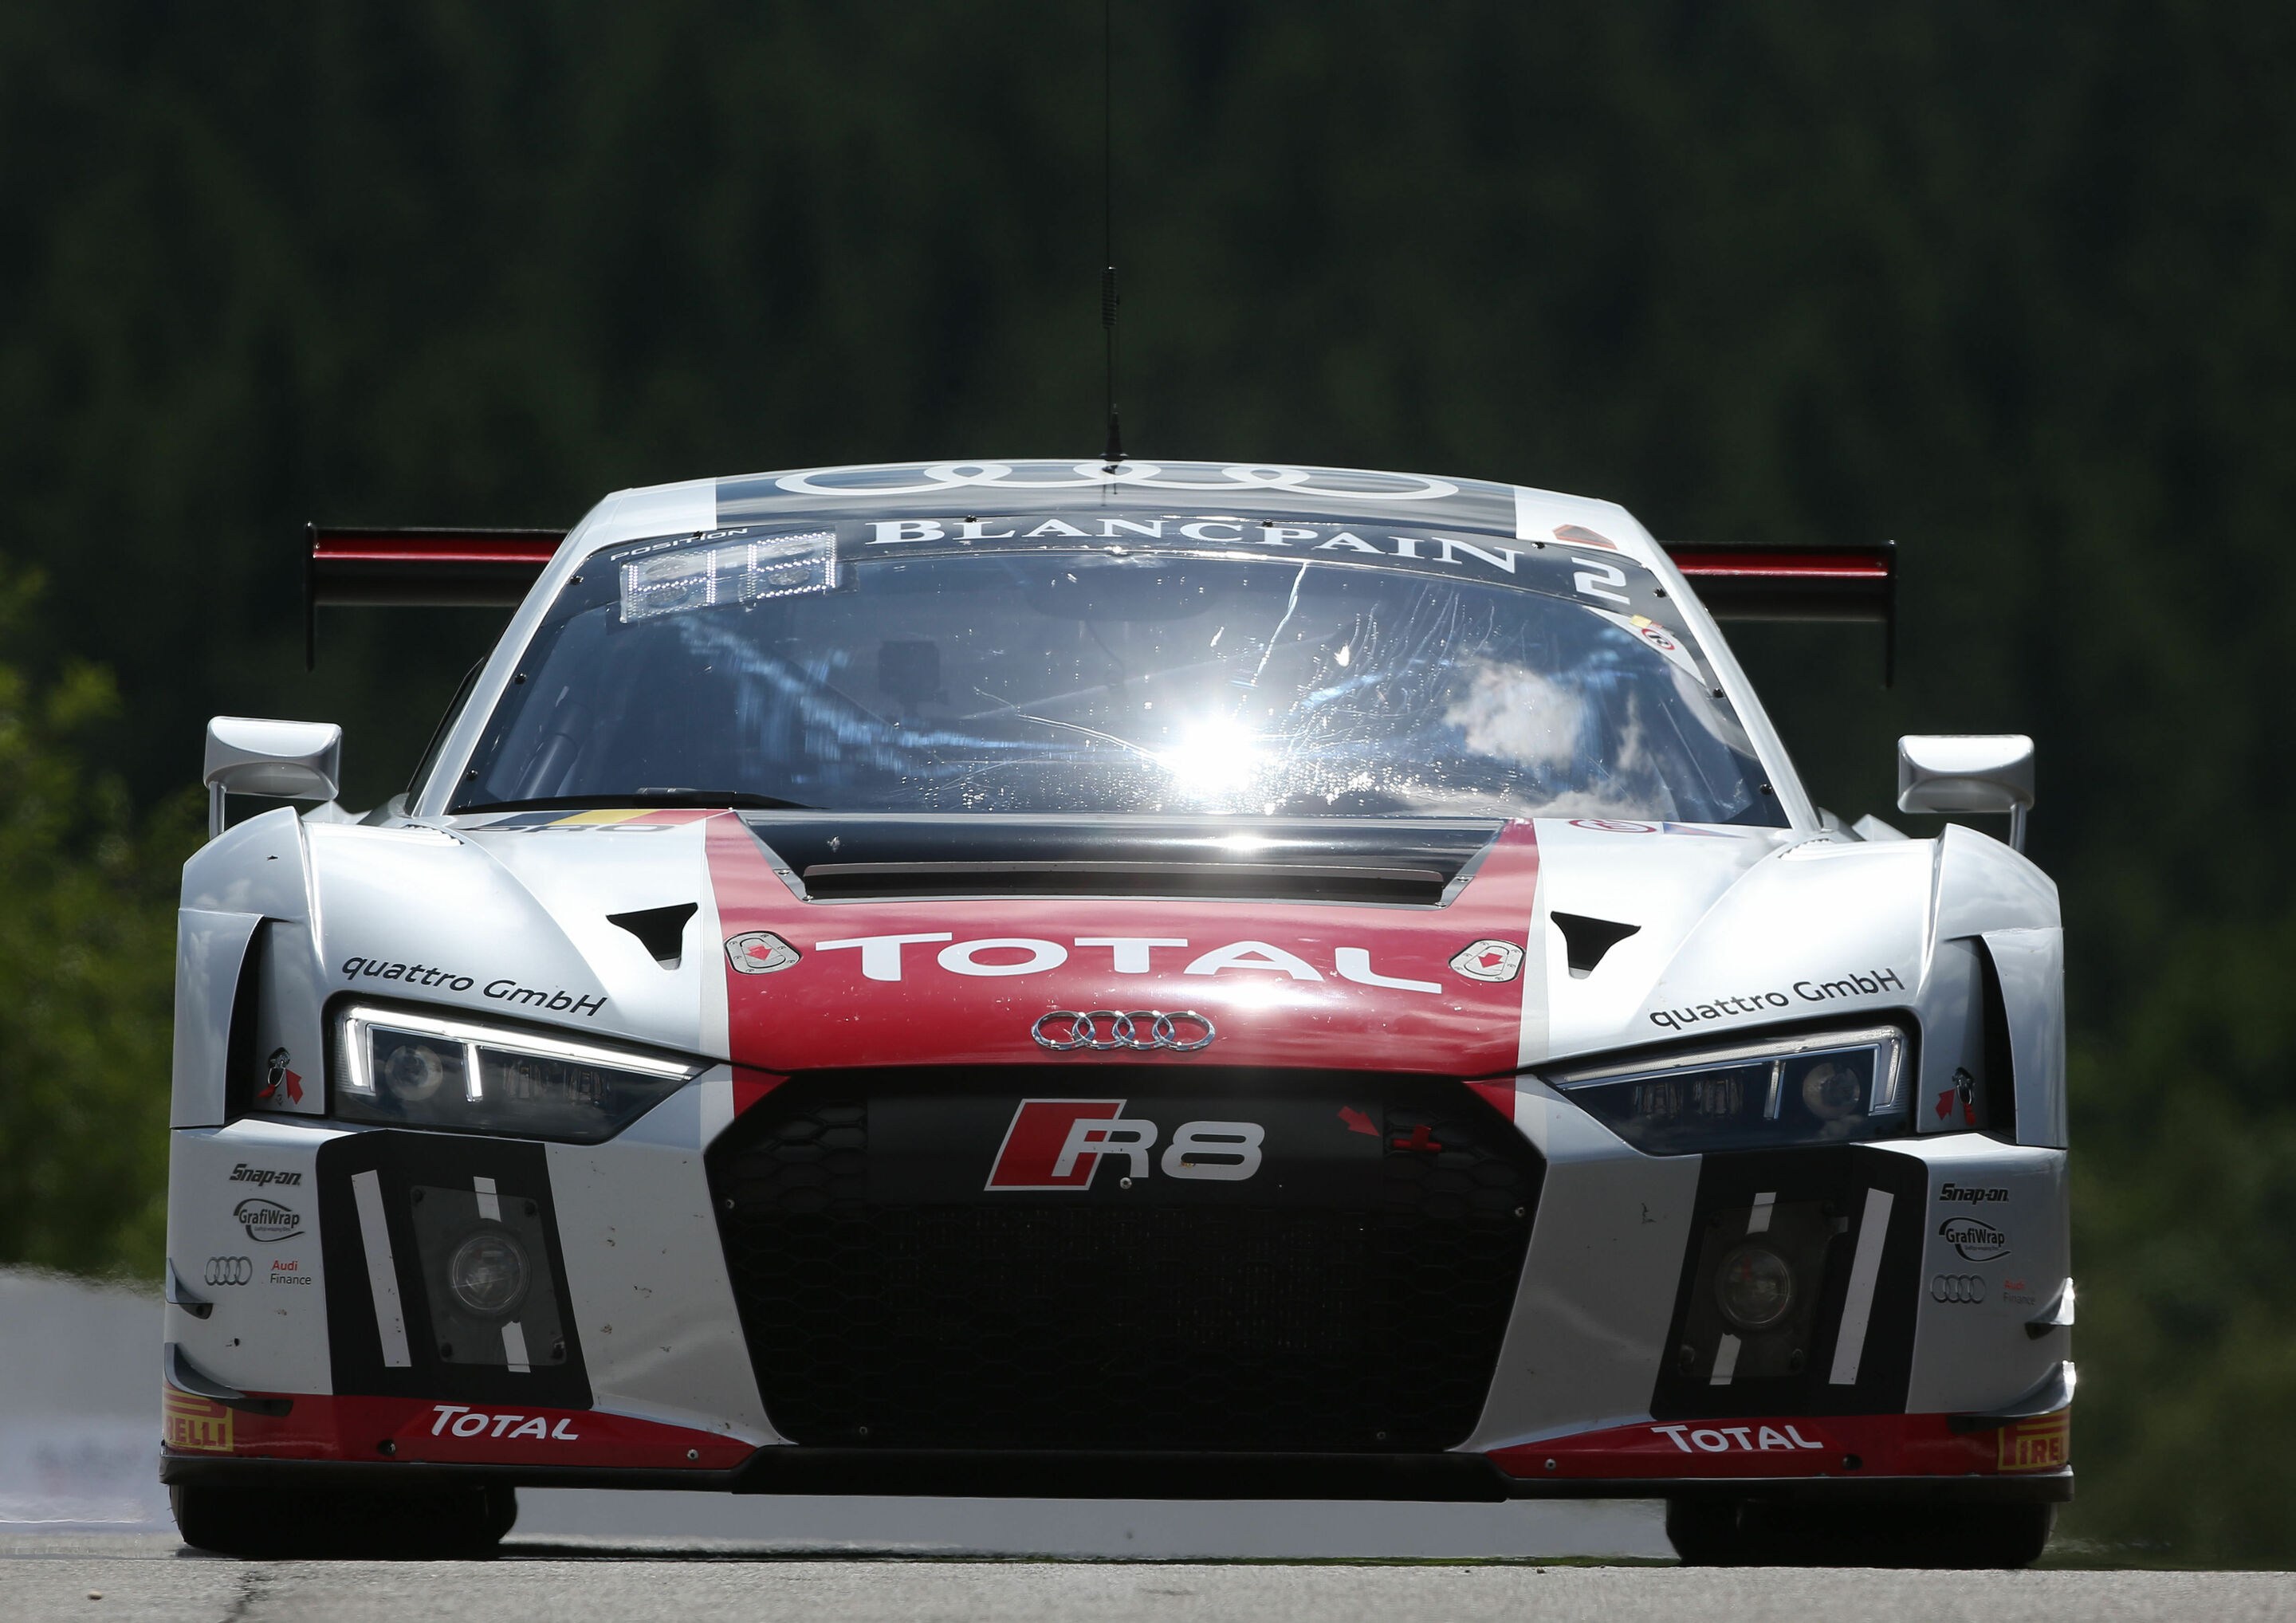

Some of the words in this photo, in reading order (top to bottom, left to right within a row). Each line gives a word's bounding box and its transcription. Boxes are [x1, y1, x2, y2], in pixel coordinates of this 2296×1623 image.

[610, 528, 748, 562] POSITION
[864, 518, 1523, 573] BLANCPAIN
[1571, 556, 1630, 606] 2
[816, 932, 1443, 993] TOTAL
[341, 956, 474, 991] quattro
[482, 978, 608, 1017] GmbH
[1649, 988, 1789, 1030] quattro
[1793, 969, 1906, 1003] GmbH
[1051, 1118, 1264, 1181] R8
[229, 1163, 301, 1187] Snap-on
[1939, 1183, 2009, 1205] Snap-on
[238, 1208, 300, 1228] GrafiWrap
[1946, 1228, 2005, 1248] GrafiWrap
[269, 1273, 312, 1286] Finance
[271, 1259, 298, 1271] Audi
[164, 1400, 227, 1448] RELLI
[431, 1405, 580, 1441] TOTAL
[1650, 1425, 1824, 1454] TOTAL
